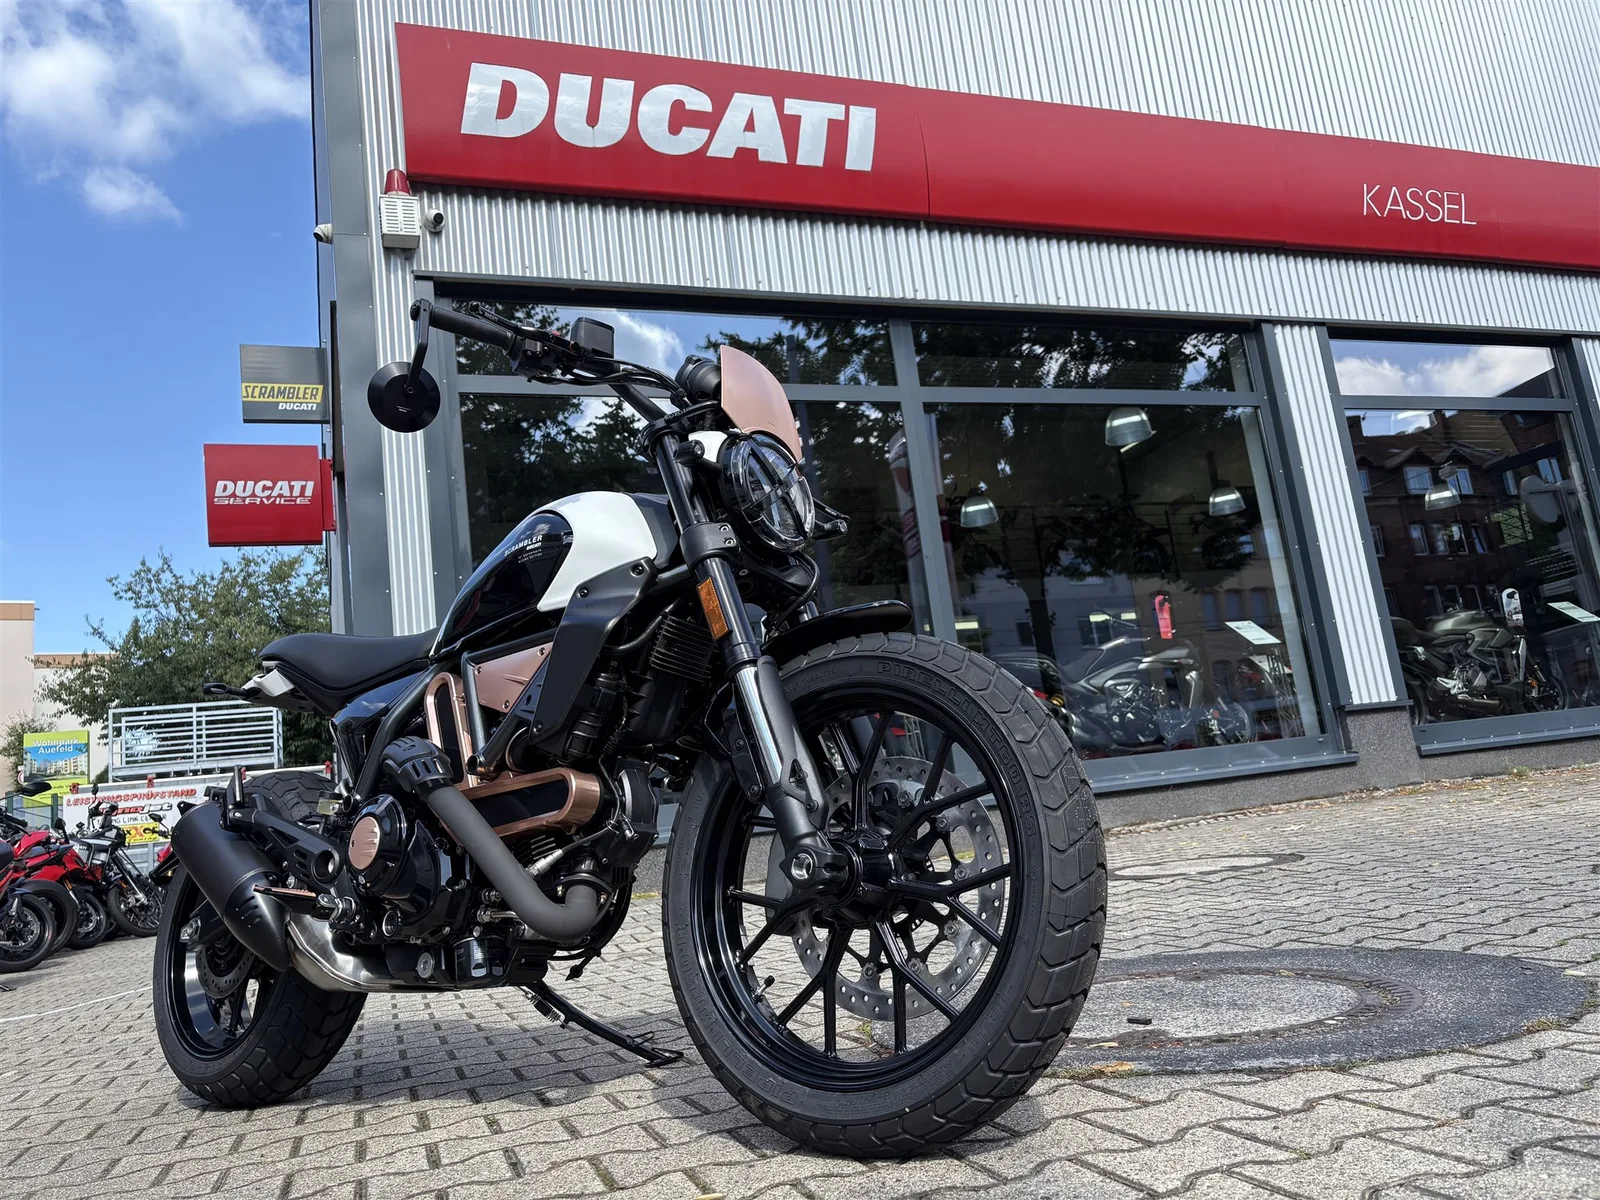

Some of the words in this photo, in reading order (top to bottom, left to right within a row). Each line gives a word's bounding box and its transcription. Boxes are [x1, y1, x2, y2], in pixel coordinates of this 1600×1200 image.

[461, 63, 877, 171] DUCATI
[1363, 183, 1477, 225] KASSEL
[242, 385, 319, 401] SCRAMBLER
[278, 402, 317, 411] DUCATI
[214, 480, 315, 497] DUCATI
[213, 497, 312, 505] SERVICE
[504, 534, 543, 557] SCRAMBLER
[877, 661, 969, 714] PIRELLI
[32, 737, 79, 748] Wohnpark
[38, 744, 74, 754] Auefeld
[122, 815, 139, 824] LINK
[710, 1033, 799, 1106] PIRELLI
